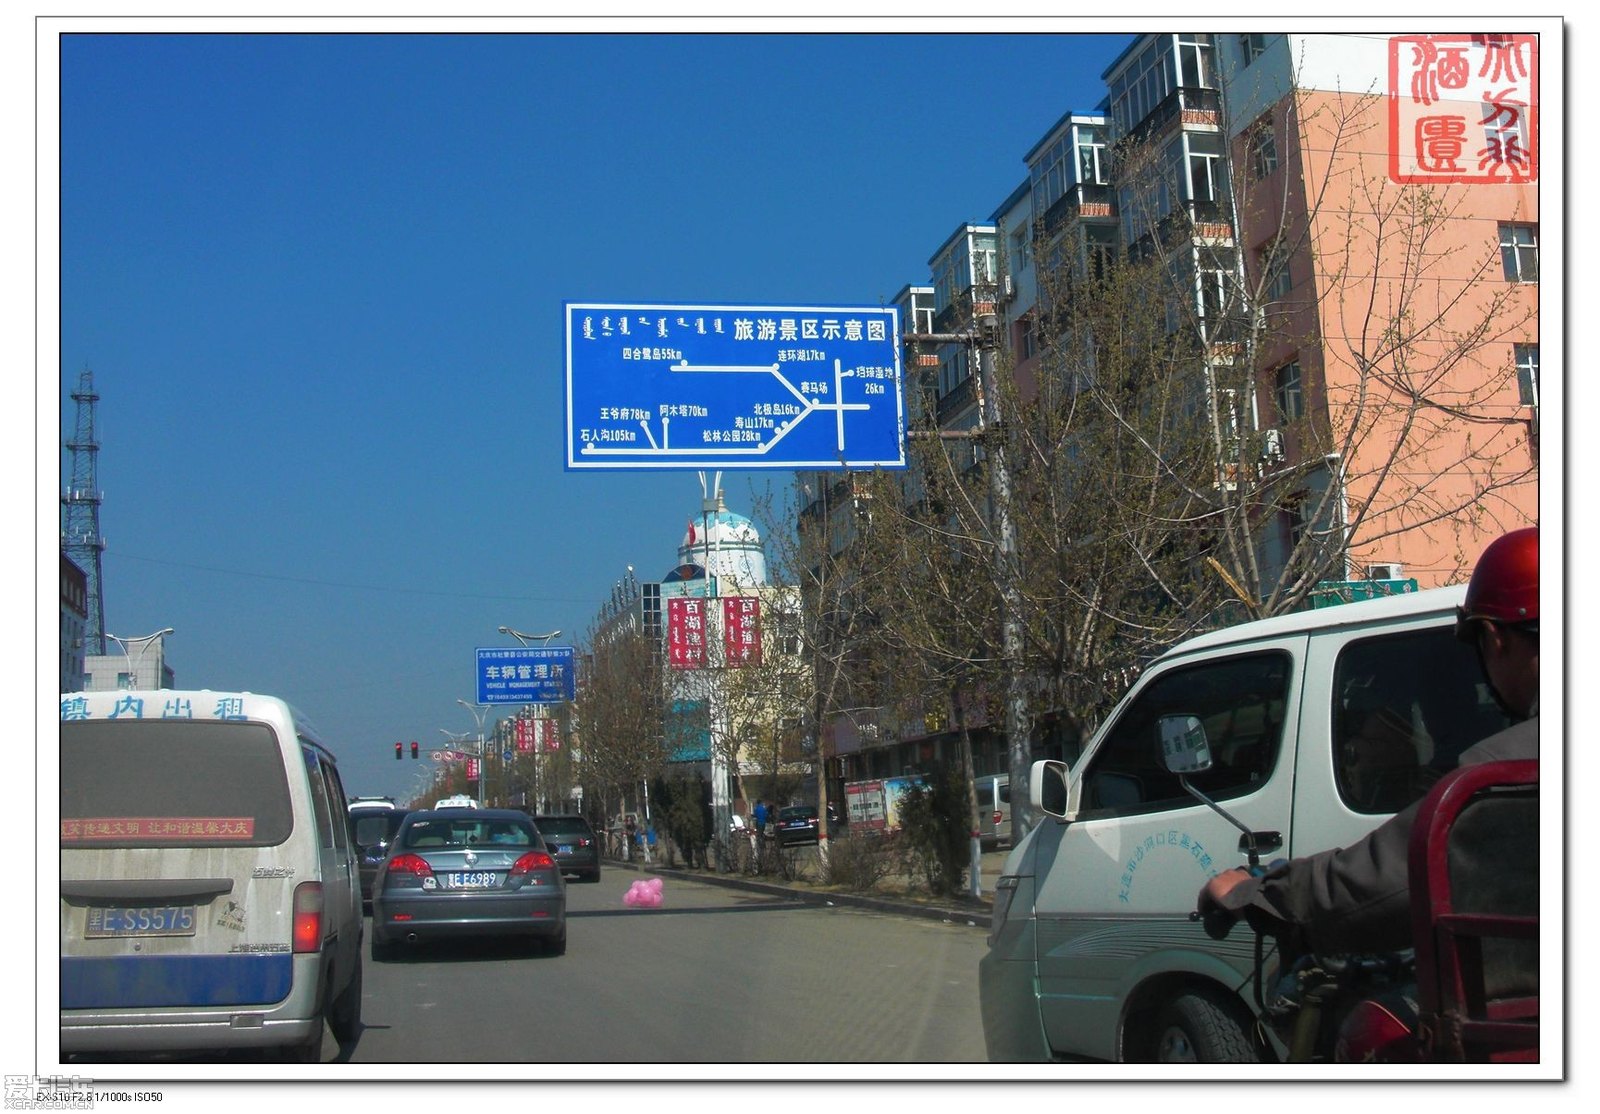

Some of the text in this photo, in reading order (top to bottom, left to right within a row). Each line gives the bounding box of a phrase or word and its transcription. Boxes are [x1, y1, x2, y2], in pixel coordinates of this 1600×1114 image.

[734, 318, 886, 341] 旅游景区示意图
[778, 350, 825, 362] 连环湖17km
[801, 382, 828, 394] 赛马场
[865, 383, 885, 394] 26km
[600, 408, 650, 420] 王爷府78km
[659, 405, 708, 417] 阿木塔70km
[754, 403, 800, 415] 北极岛16km
[735, 417, 774, 429] 寿山17km
[580, 429, 636, 441] 石人沟105km
[703, 430, 761, 442] 松林公园28km
[485, 664, 564, 679] 车辆管理所
[61, 695, 248, 721] 镇内出租
